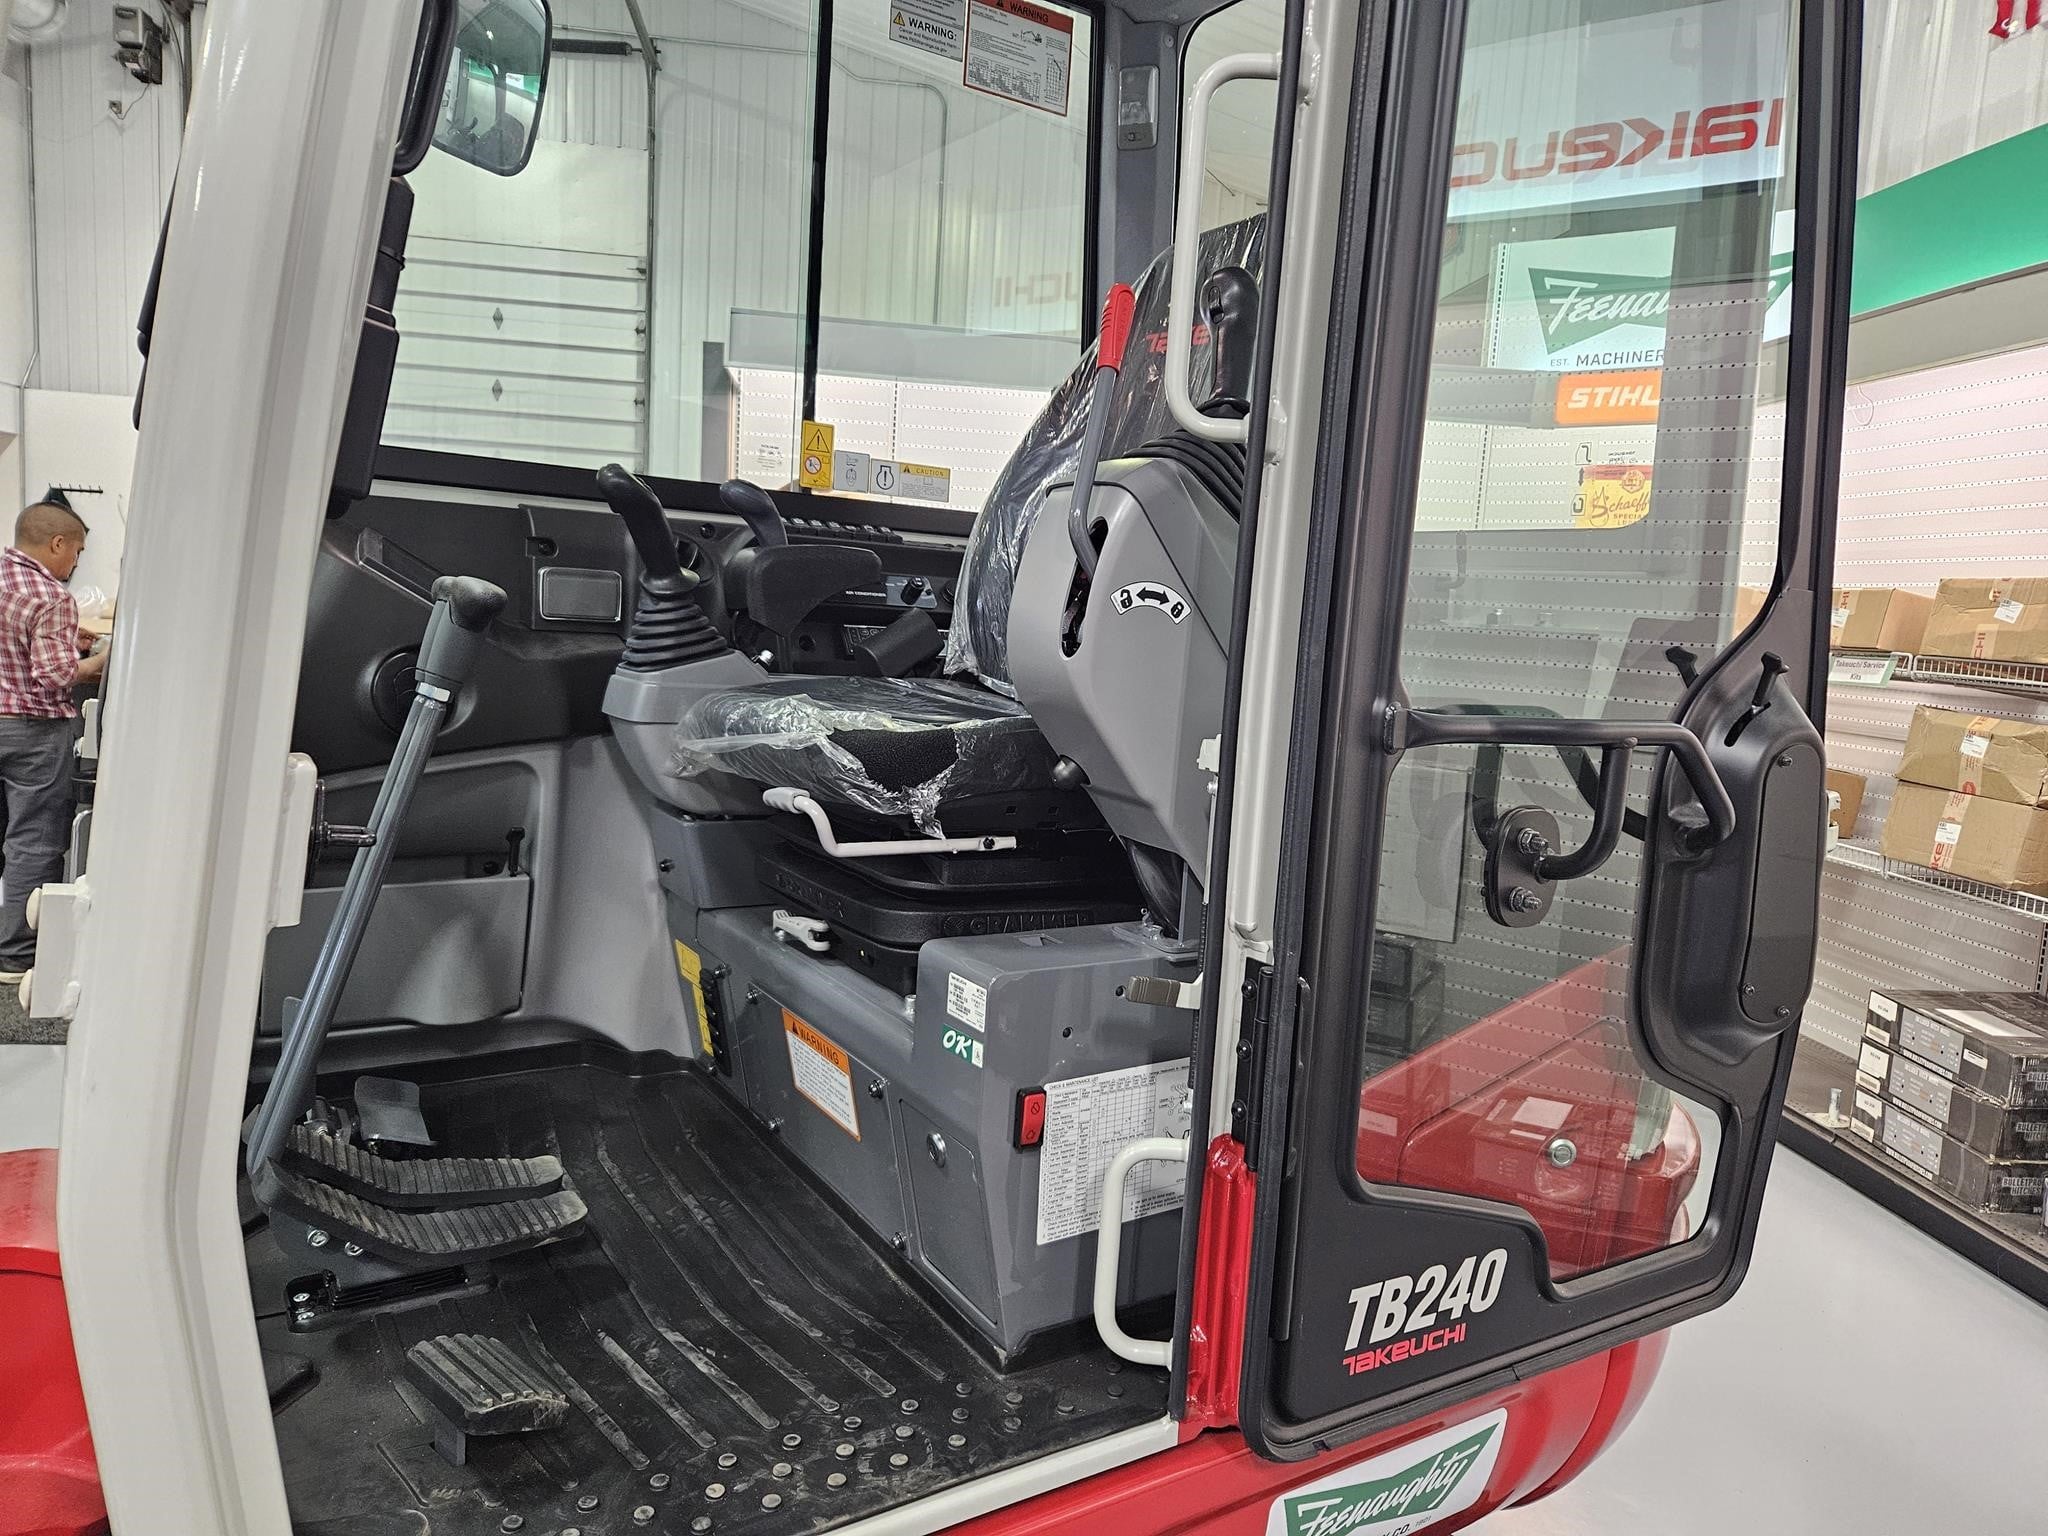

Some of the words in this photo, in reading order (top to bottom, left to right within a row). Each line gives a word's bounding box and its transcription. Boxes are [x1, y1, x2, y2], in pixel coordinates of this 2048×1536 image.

[1009, 3, 1049, 23] WARNING
[908, 16, 957, 41] WARNING:
[1550, 358, 1570, 367] EST.
[1567, 384, 1661, 409] STIHL
[915, 467, 944, 477] CAUTION
[1836, 659, 1863, 668] Takeuchi
[1863, 661, 1886, 669] Service
[1850, 673, 1862, 681] Kits
[799, 1028, 840, 1065] WARNING
[942, 1030, 972, 1059] OK
[1344, 1247, 1509, 1352] TB240
[1342, 1322, 1467, 1376] TAKEUCHI
[1297, 1443, 1481, 1536] Feenaughty
